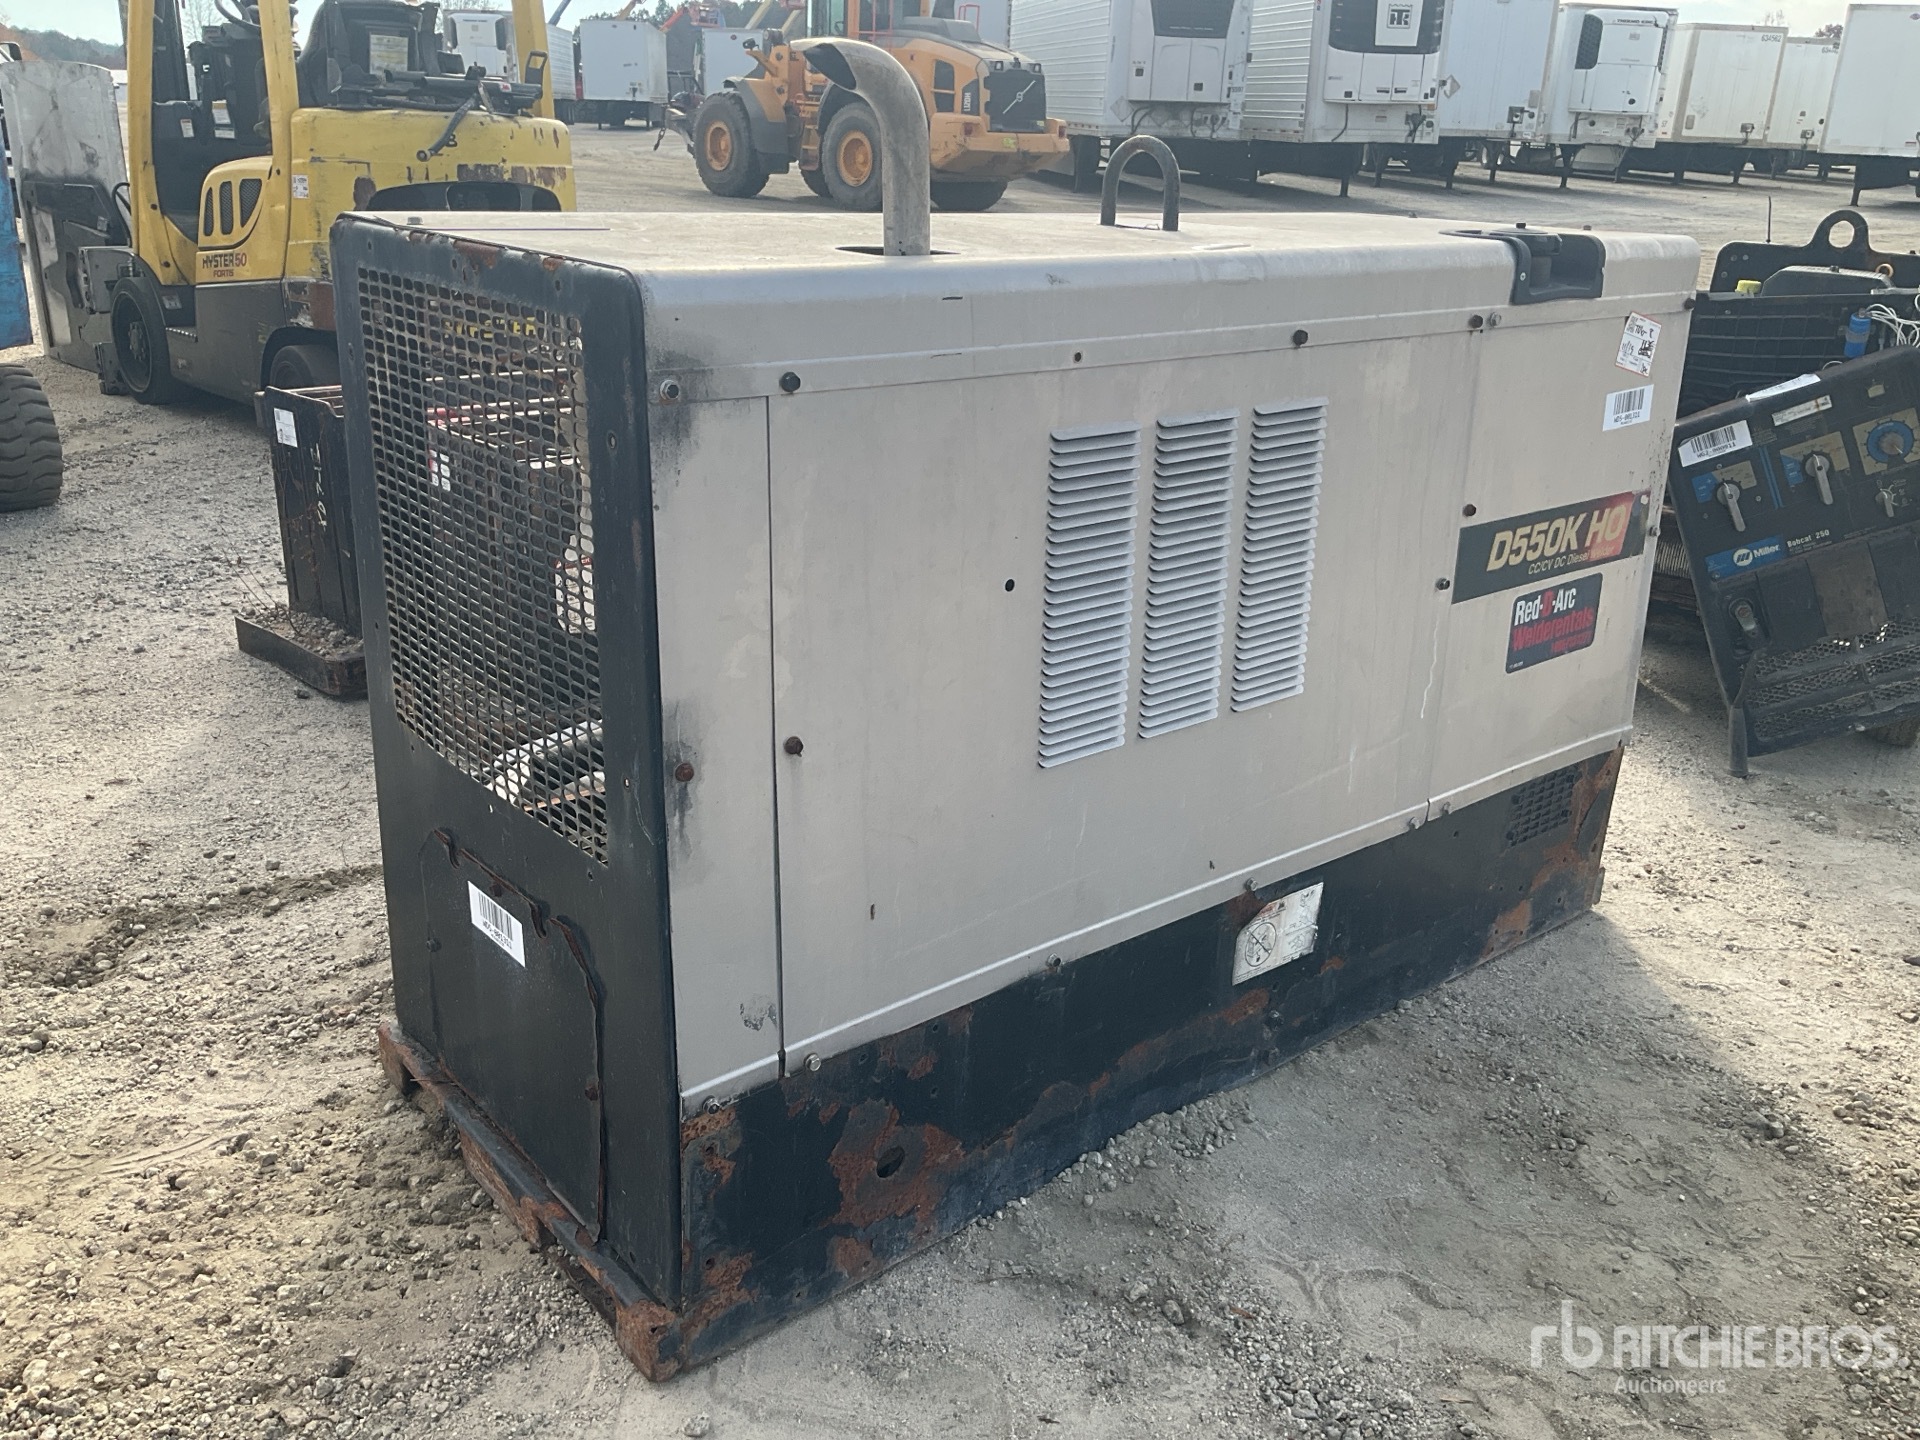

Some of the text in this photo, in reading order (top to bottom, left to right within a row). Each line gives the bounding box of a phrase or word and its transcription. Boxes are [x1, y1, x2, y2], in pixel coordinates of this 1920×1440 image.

[202, 252, 248, 269] HYSTER 50
[213, 269, 234, 278] FORTIS
[1486, 504, 1627, 573] D550K HO
[1786, 534, 1812, 548] Bobcat
[1815, 529, 1830, 539] 250
[1752, 544, 1780, 558] Miller
[1528, 558, 1554, 575] CC/CV
[1553, 554, 1567, 570] DC
[1566, 551, 1590, 566] Diesel
[1512, 606, 1595, 652] Welderentals
